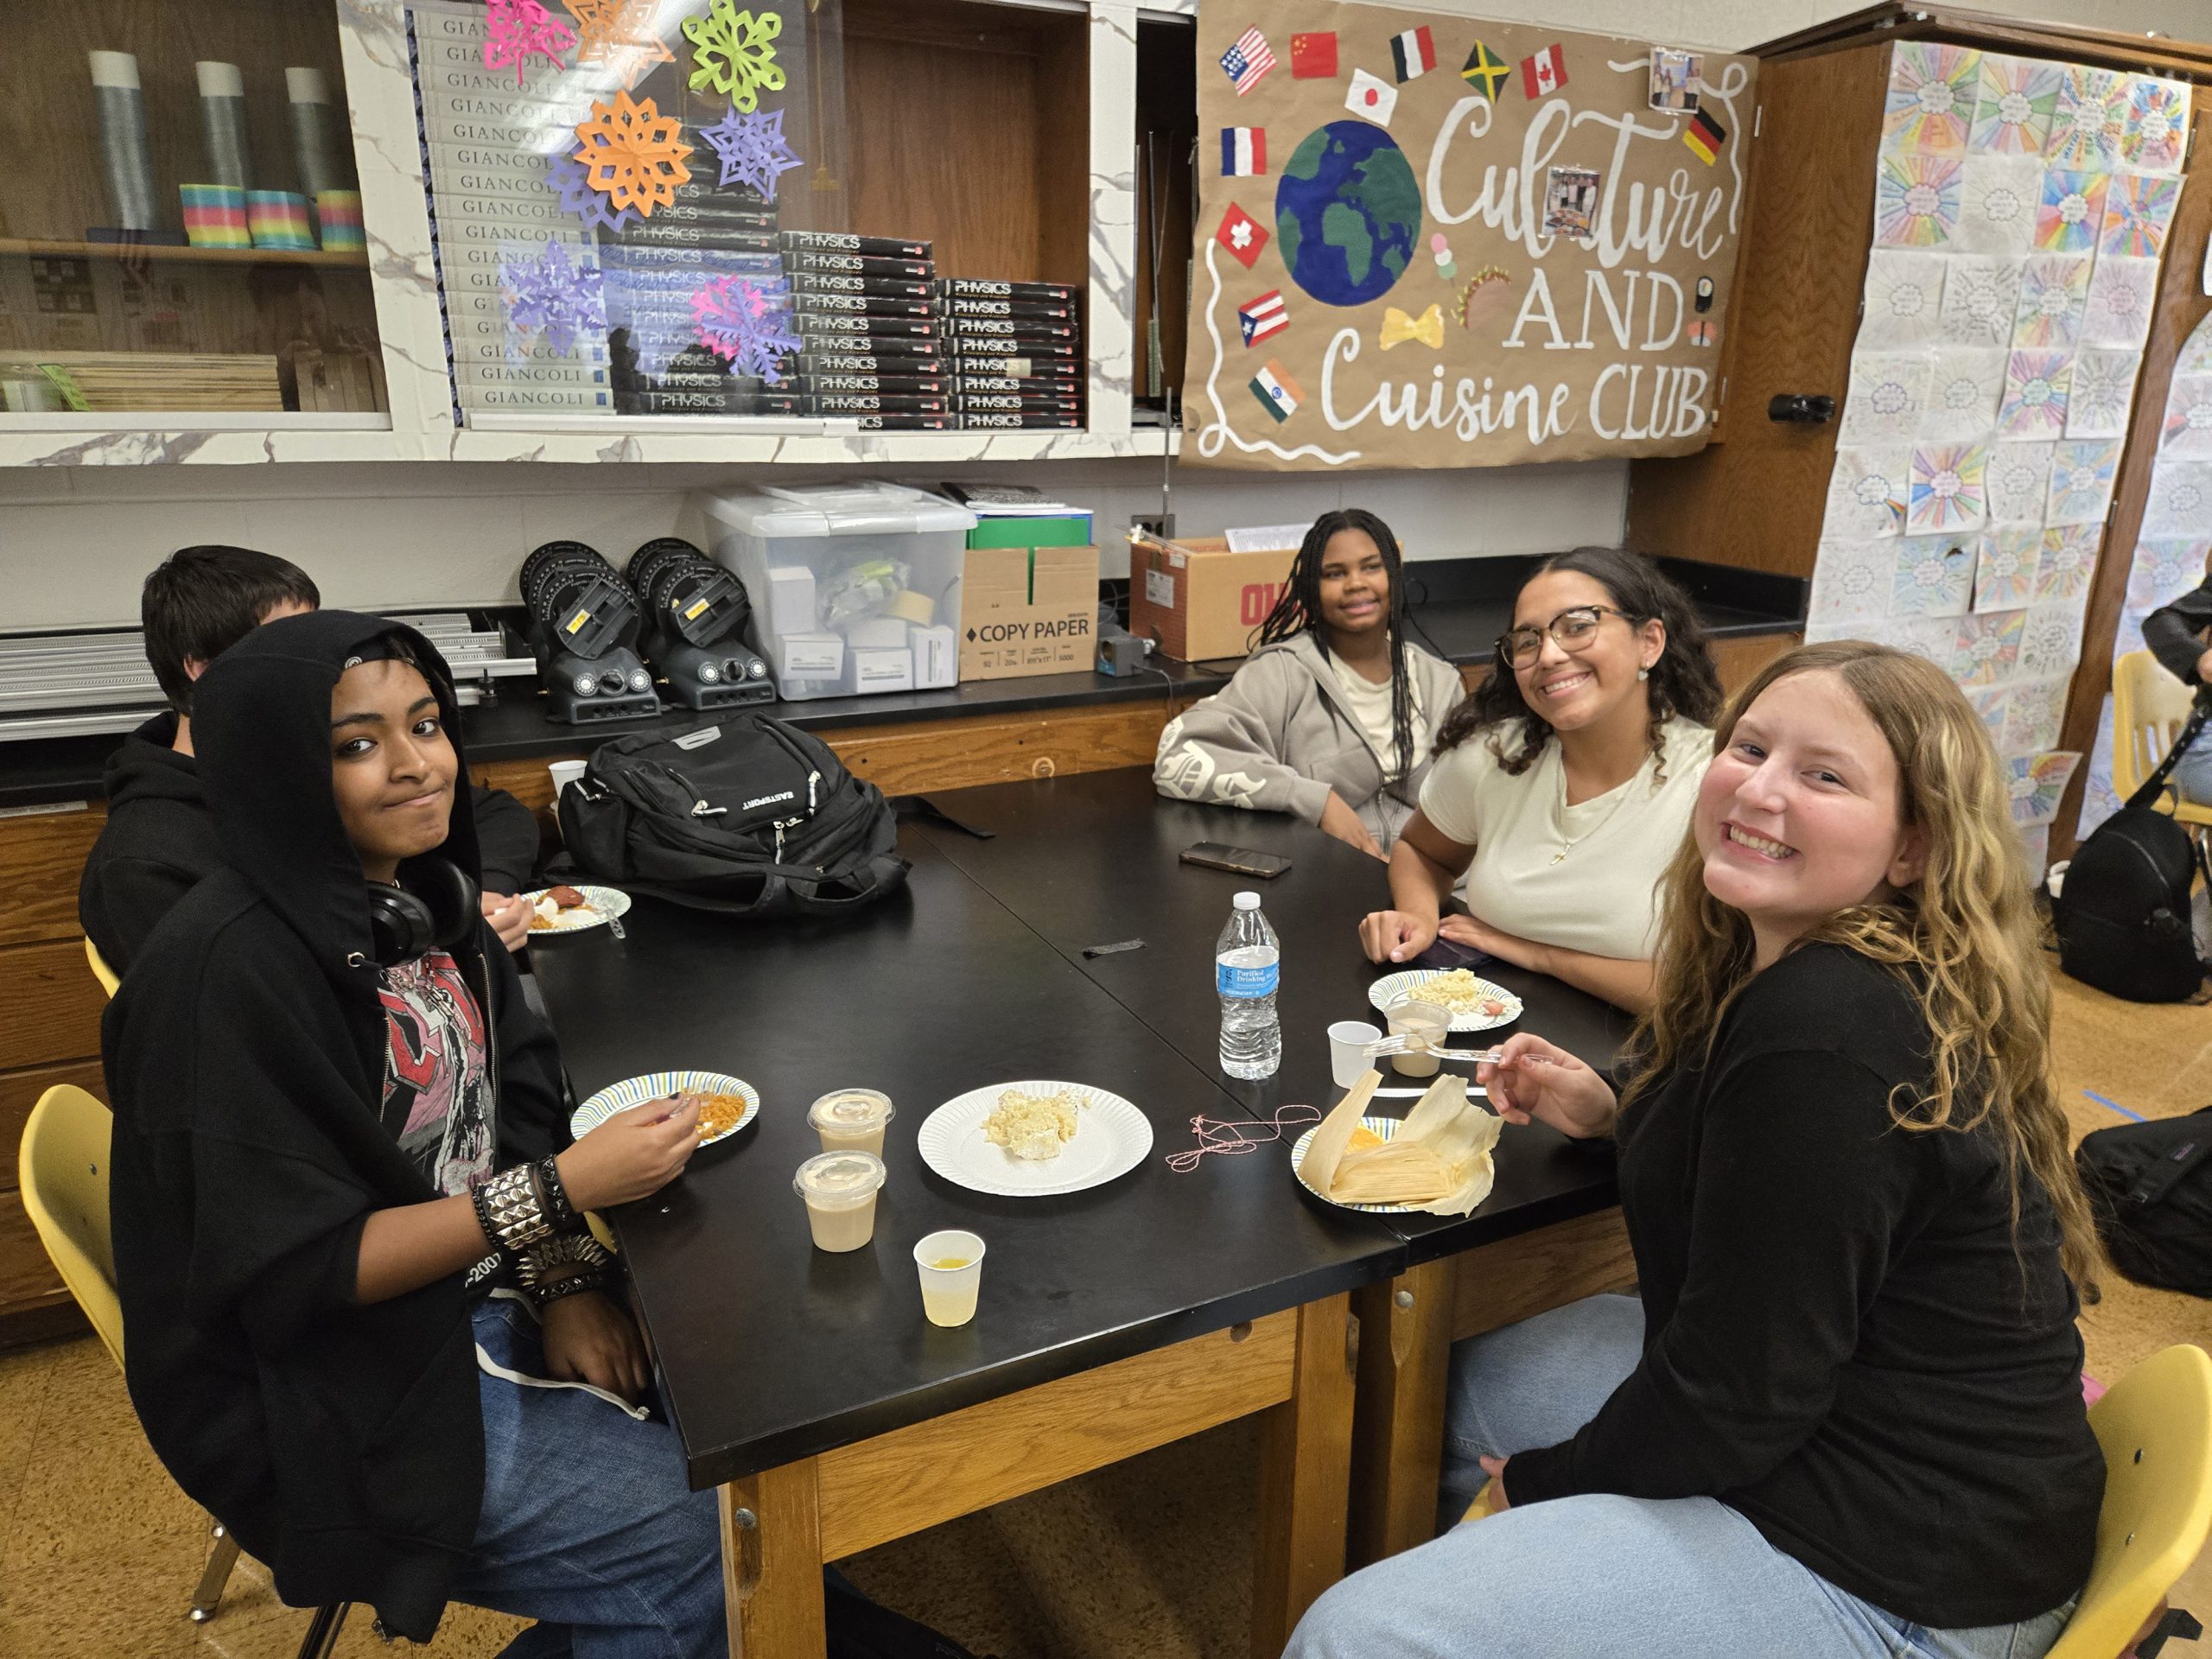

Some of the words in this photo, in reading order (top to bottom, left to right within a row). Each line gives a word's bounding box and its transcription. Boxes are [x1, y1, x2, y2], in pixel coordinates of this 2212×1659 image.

[458, 149, 554, 170] GIANCOL
[466, 226, 567, 244] GIANCOLI
[632, 225, 700, 242] PHYSICS
[799, 234, 861, 249] PHYSICS
[635, 248, 702, 264] PHYSICS
[803, 254, 864, 270] PHYSICS
[640, 270, 706, 285] PHYSICS
[804, 276, 865, 290] PHYSICS
[954, 280, 1012, 295] PHYSICS
[644, 290, 694, 304] PHYSI
[806, 296, 868, 310] PHYSICS
[953, 300, 1011, 315] PHYSICS
[1501, 267, 1685, 352] AND
[809, 316, 870, 331] PHYSICS
[958, 320, 1015, 334] PHYSICS
[811, 337, 872, 351] PHYSICS
[962, 339, 1018, 353] PHYSICS
[652, 353, 717, 367] PHYSICS
[819, 357, 878, 370] PHYSICS
[481, 366, 581, 382] GIANCOLI
[658, 373, 722, 387] PHYSICS
[821, 377, 880, 390] PHYSICS
[964, 378, 1020, 391] PHYSICS
[1320, 327, 1579, 447] Cuisine
[1589, 363, 1708, 441] CLUB
[485, 391, 583, 405] GIANCOLI
[661, 395, 726, 408] PHYSICS
[822, 397, 880, 410] PHYSICS
[967, 396, 1023, 409] PHYSICS
[967, 414, 1023, 427] PHYSICS
[979, 624, 1030, 643] COPY
[1033, 619, 1089, 639] PAPER
[741, 791, 795, 811] EASTSPORT
